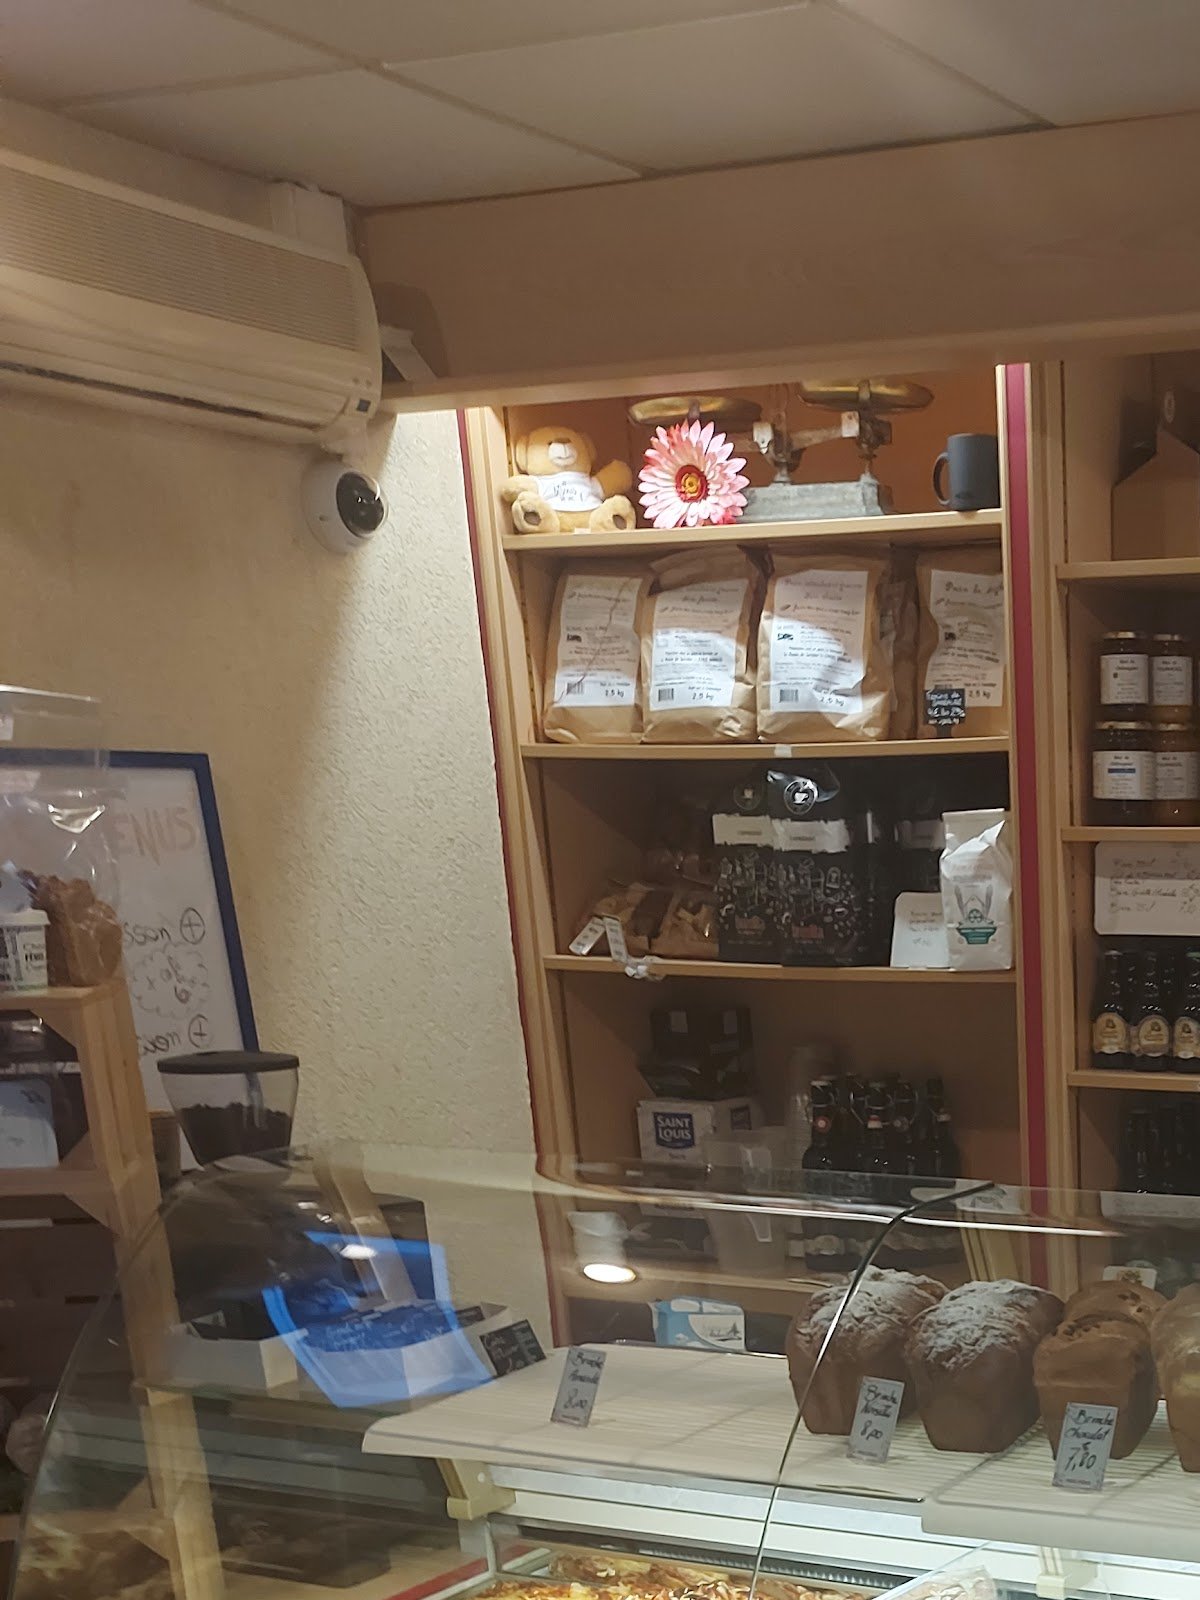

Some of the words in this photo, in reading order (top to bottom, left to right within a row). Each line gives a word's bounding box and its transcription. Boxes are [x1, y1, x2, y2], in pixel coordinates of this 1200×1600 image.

[115, 806, 197, 866] ENUS
[656, 1115, 690, 1128] SAINT
[659, 1129, 692, 1142] LOUIS
